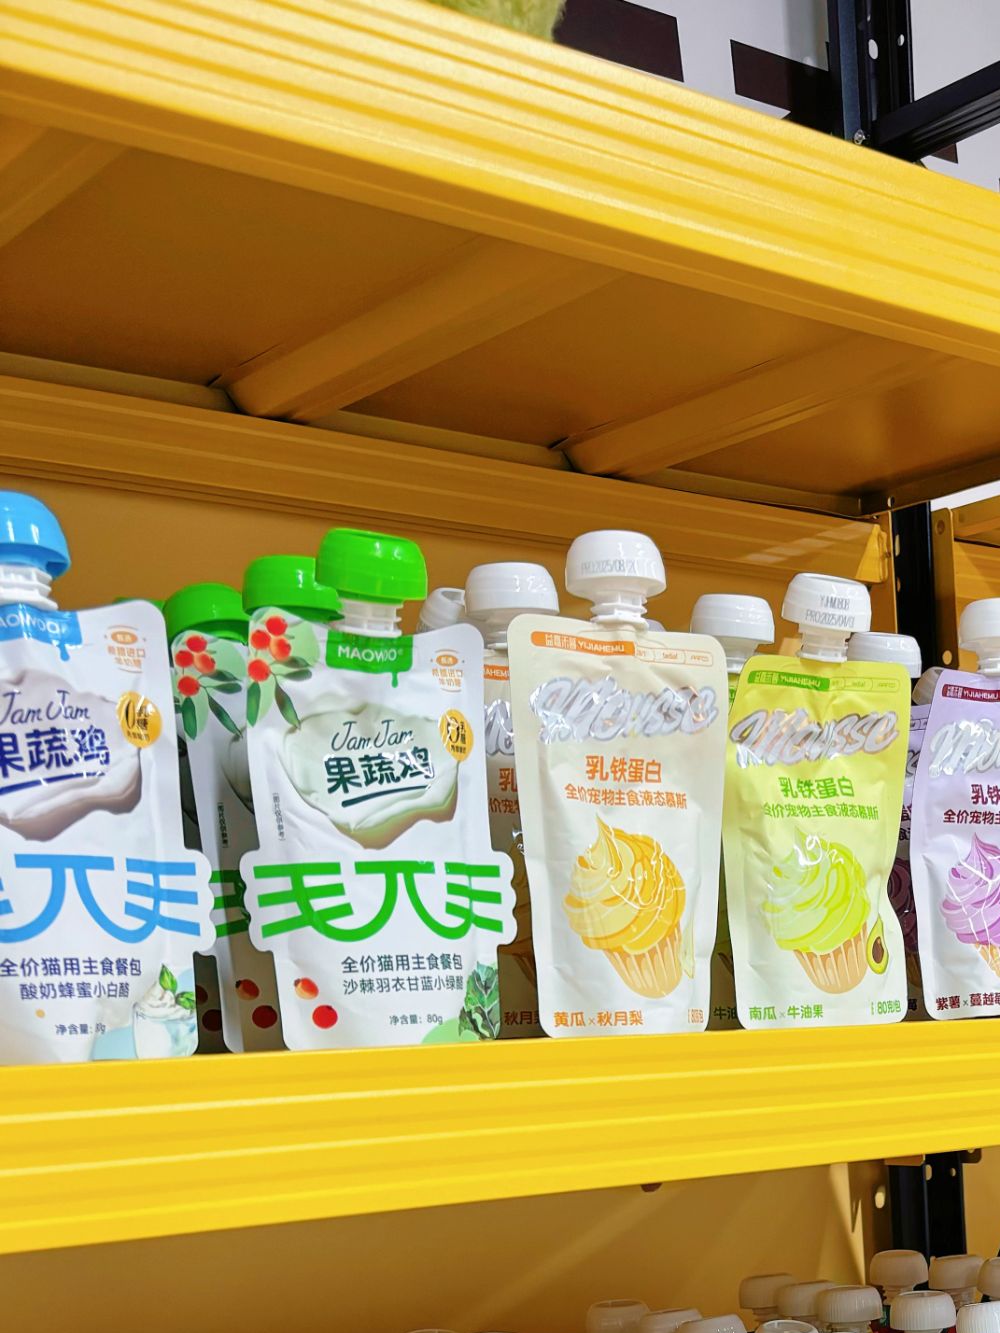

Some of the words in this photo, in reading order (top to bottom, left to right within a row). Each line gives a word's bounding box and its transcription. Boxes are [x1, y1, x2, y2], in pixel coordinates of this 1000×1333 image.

[46, 690, 90, 721] Jam
[332, 720, 370, 750] Jam
[374, 719, 413, 748] Jam
[729, 708, 902, 769] Mousse
[585, 754, 663, 784] 乳铁蛋白
[564, 783, 688, 810] 全价宠物主食液态慕斯
[778, 776, 855, 800] 乳铁蛋白
[0, 956, 142, 978] 全价猫用主食餐包
[341, 951, 463, 974] 全价猫用主食餐包
